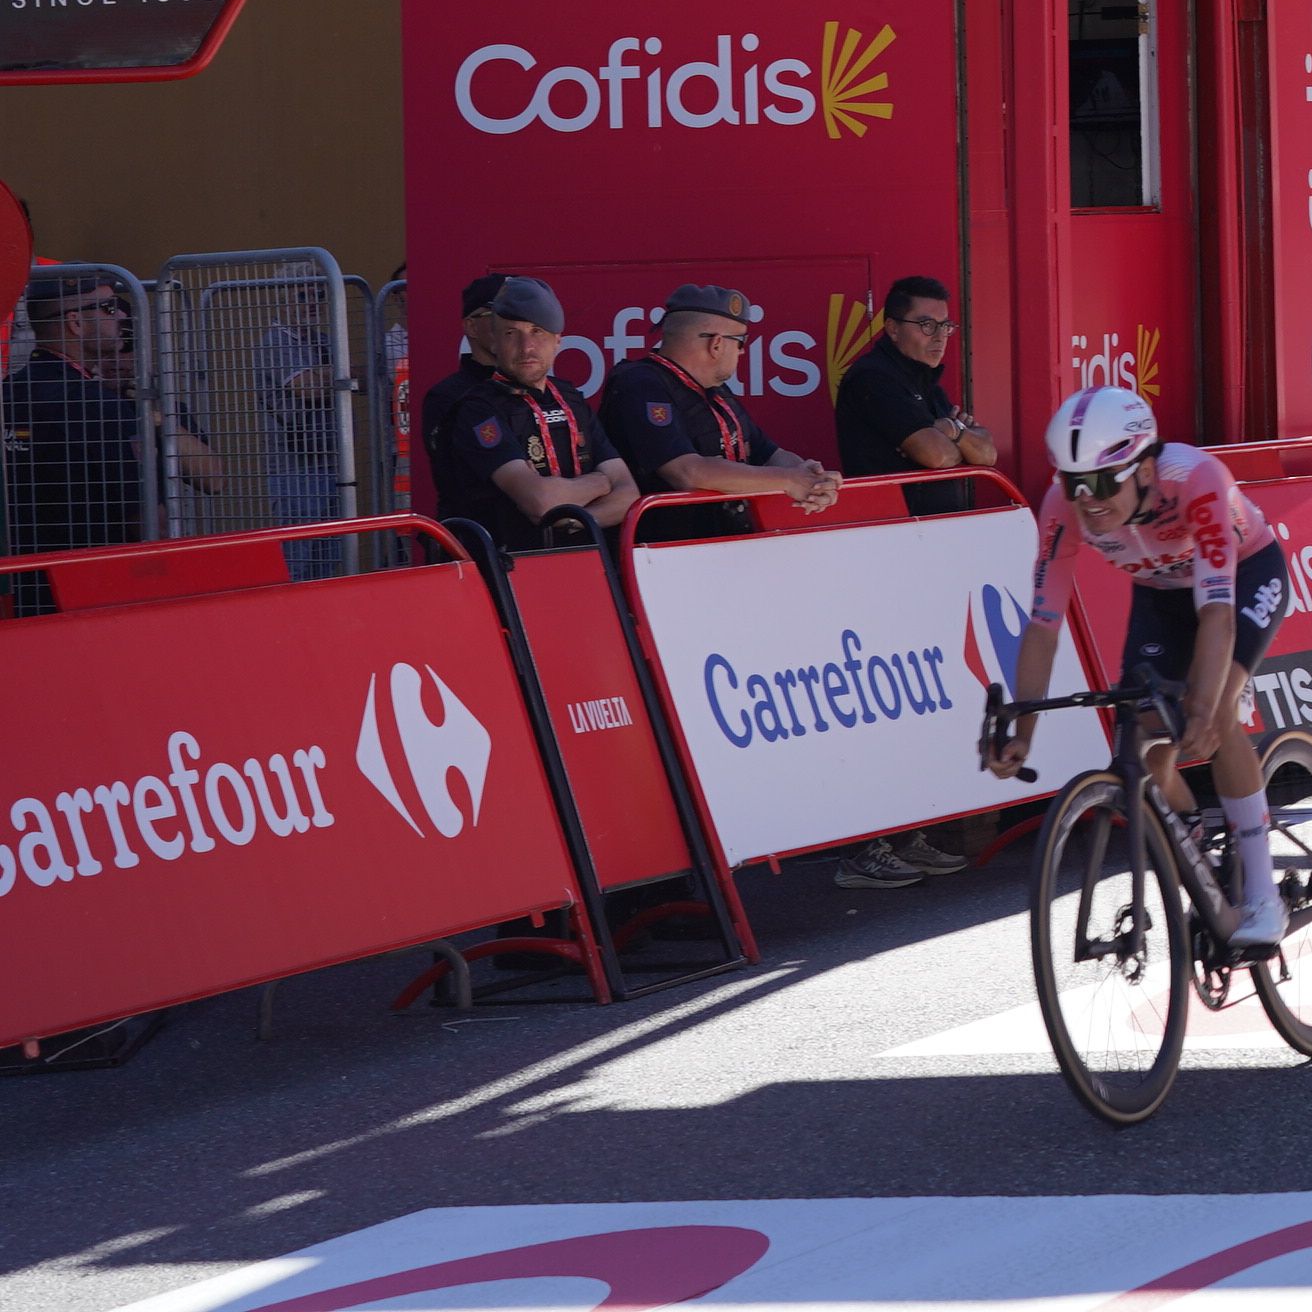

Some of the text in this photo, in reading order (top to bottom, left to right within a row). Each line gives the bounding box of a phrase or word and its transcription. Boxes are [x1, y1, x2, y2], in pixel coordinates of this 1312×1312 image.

[454, 32, 817, 135] Cofidis
[567, 696, 633, 734] LA VUELTA
[704, 628, 954, 749] Carrefour
[0, 730, 335, 892] arrefour
